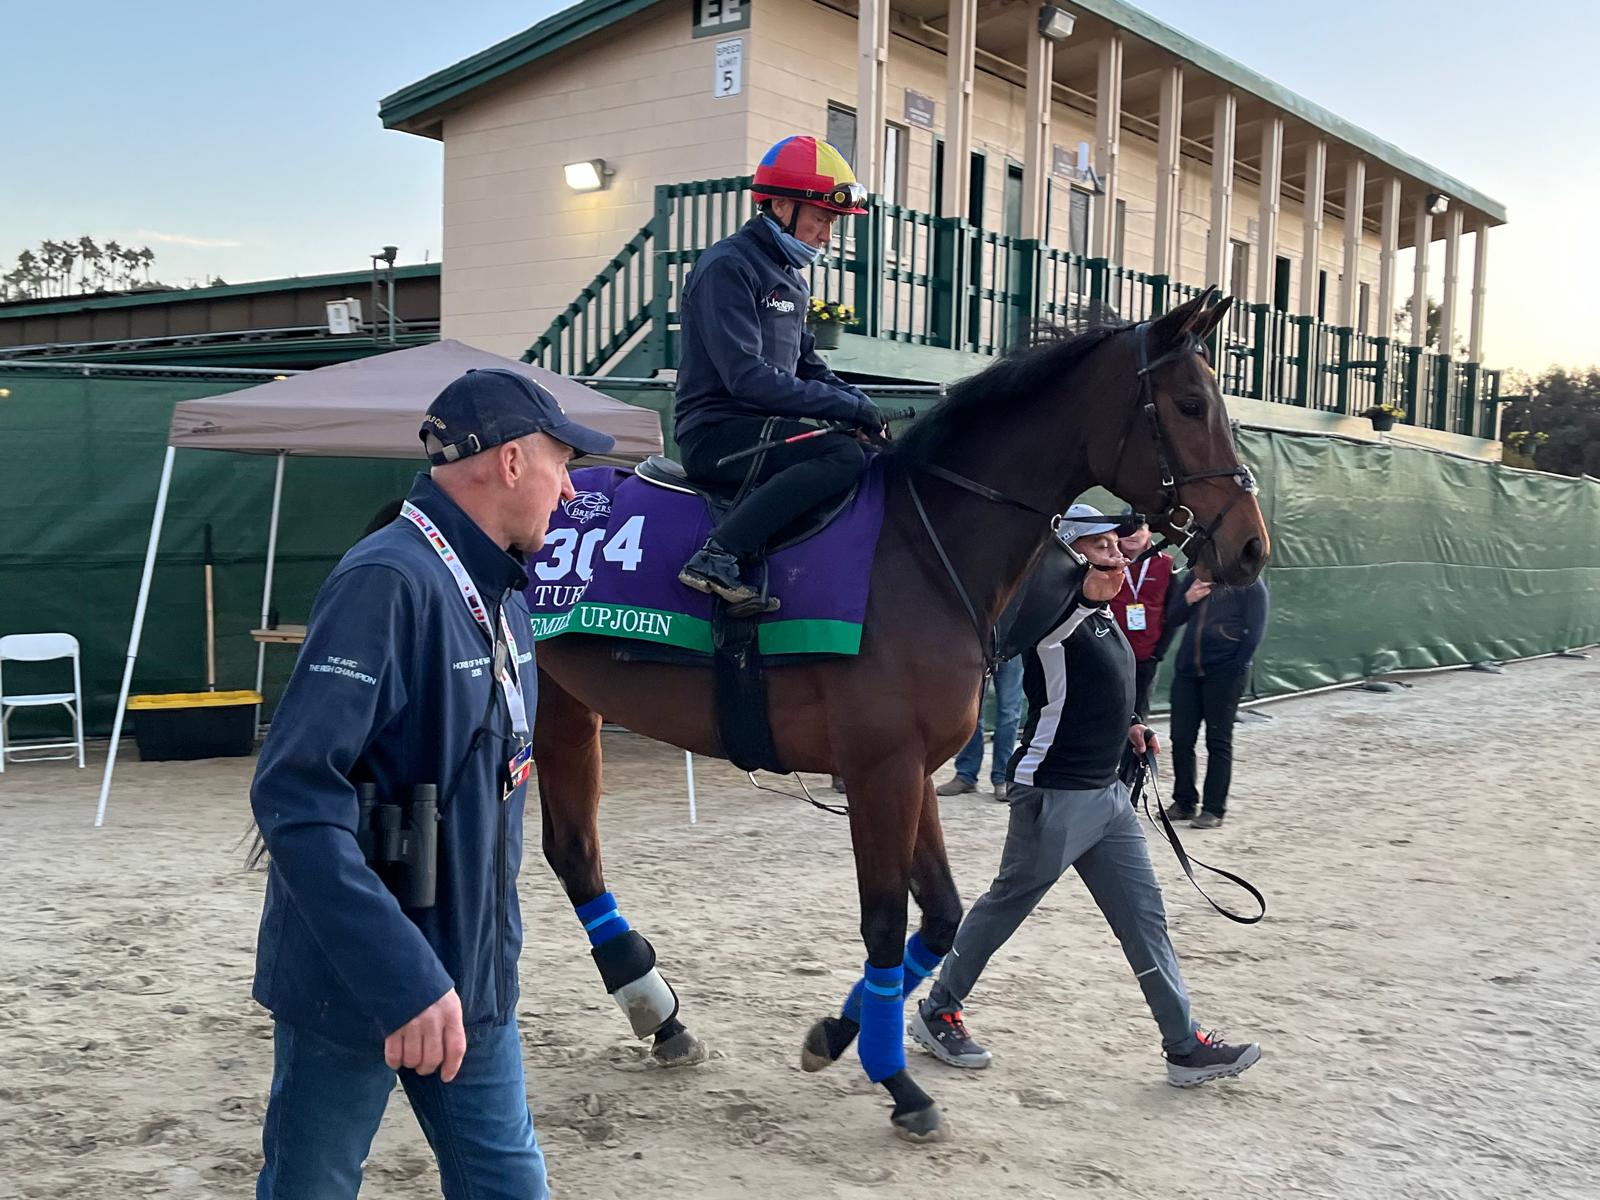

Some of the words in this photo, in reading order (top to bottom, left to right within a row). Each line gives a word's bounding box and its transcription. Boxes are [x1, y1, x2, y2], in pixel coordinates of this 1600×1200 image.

[716, 44, 741, 56] SPEED
[719, 56, 738, 68] LIMIT
[723, 70, 733, 92] 5
[580, 606, 673, 636] UPJOHN
[327, 656, 341, 665] THE
[340, 658, 358, 669] ARC
[334, 666, 377, 685] CHAMPION
